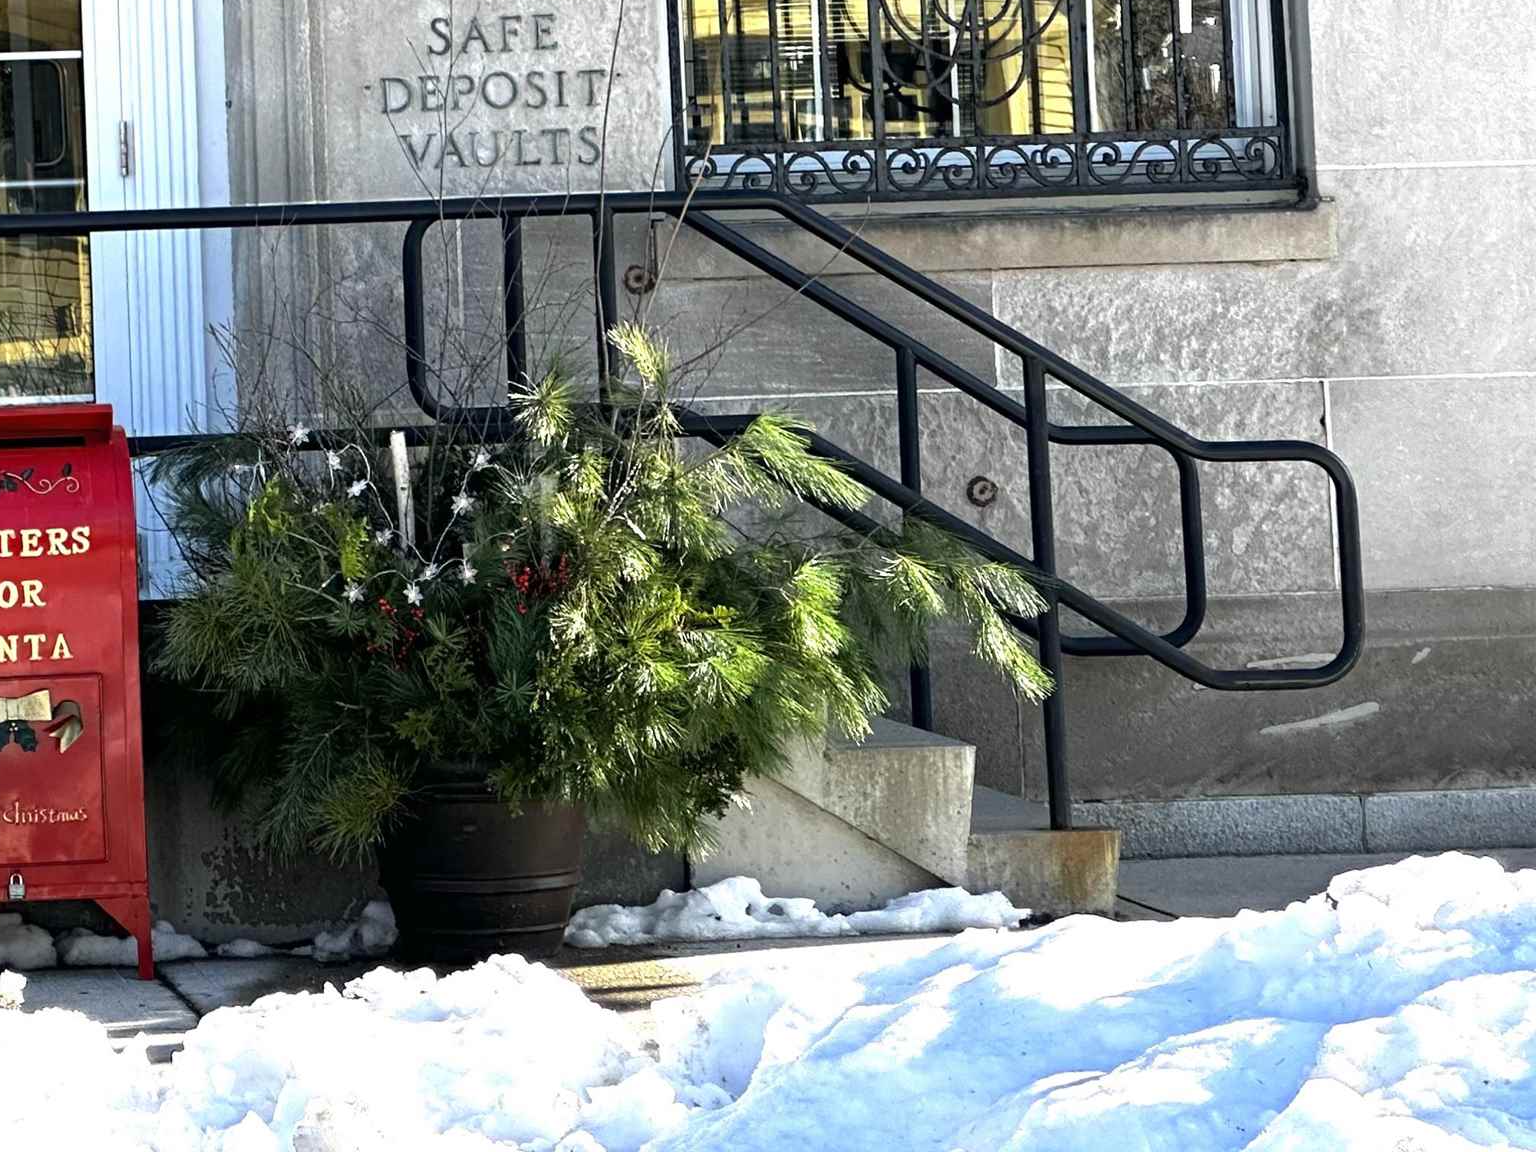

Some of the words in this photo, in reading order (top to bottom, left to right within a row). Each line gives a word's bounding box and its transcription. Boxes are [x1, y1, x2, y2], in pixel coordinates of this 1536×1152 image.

[428, 14, 558, 56] SAFE
[380, 68, 606, 114] DEPOSIT
[400, 125, 602, 171] VAULTS
